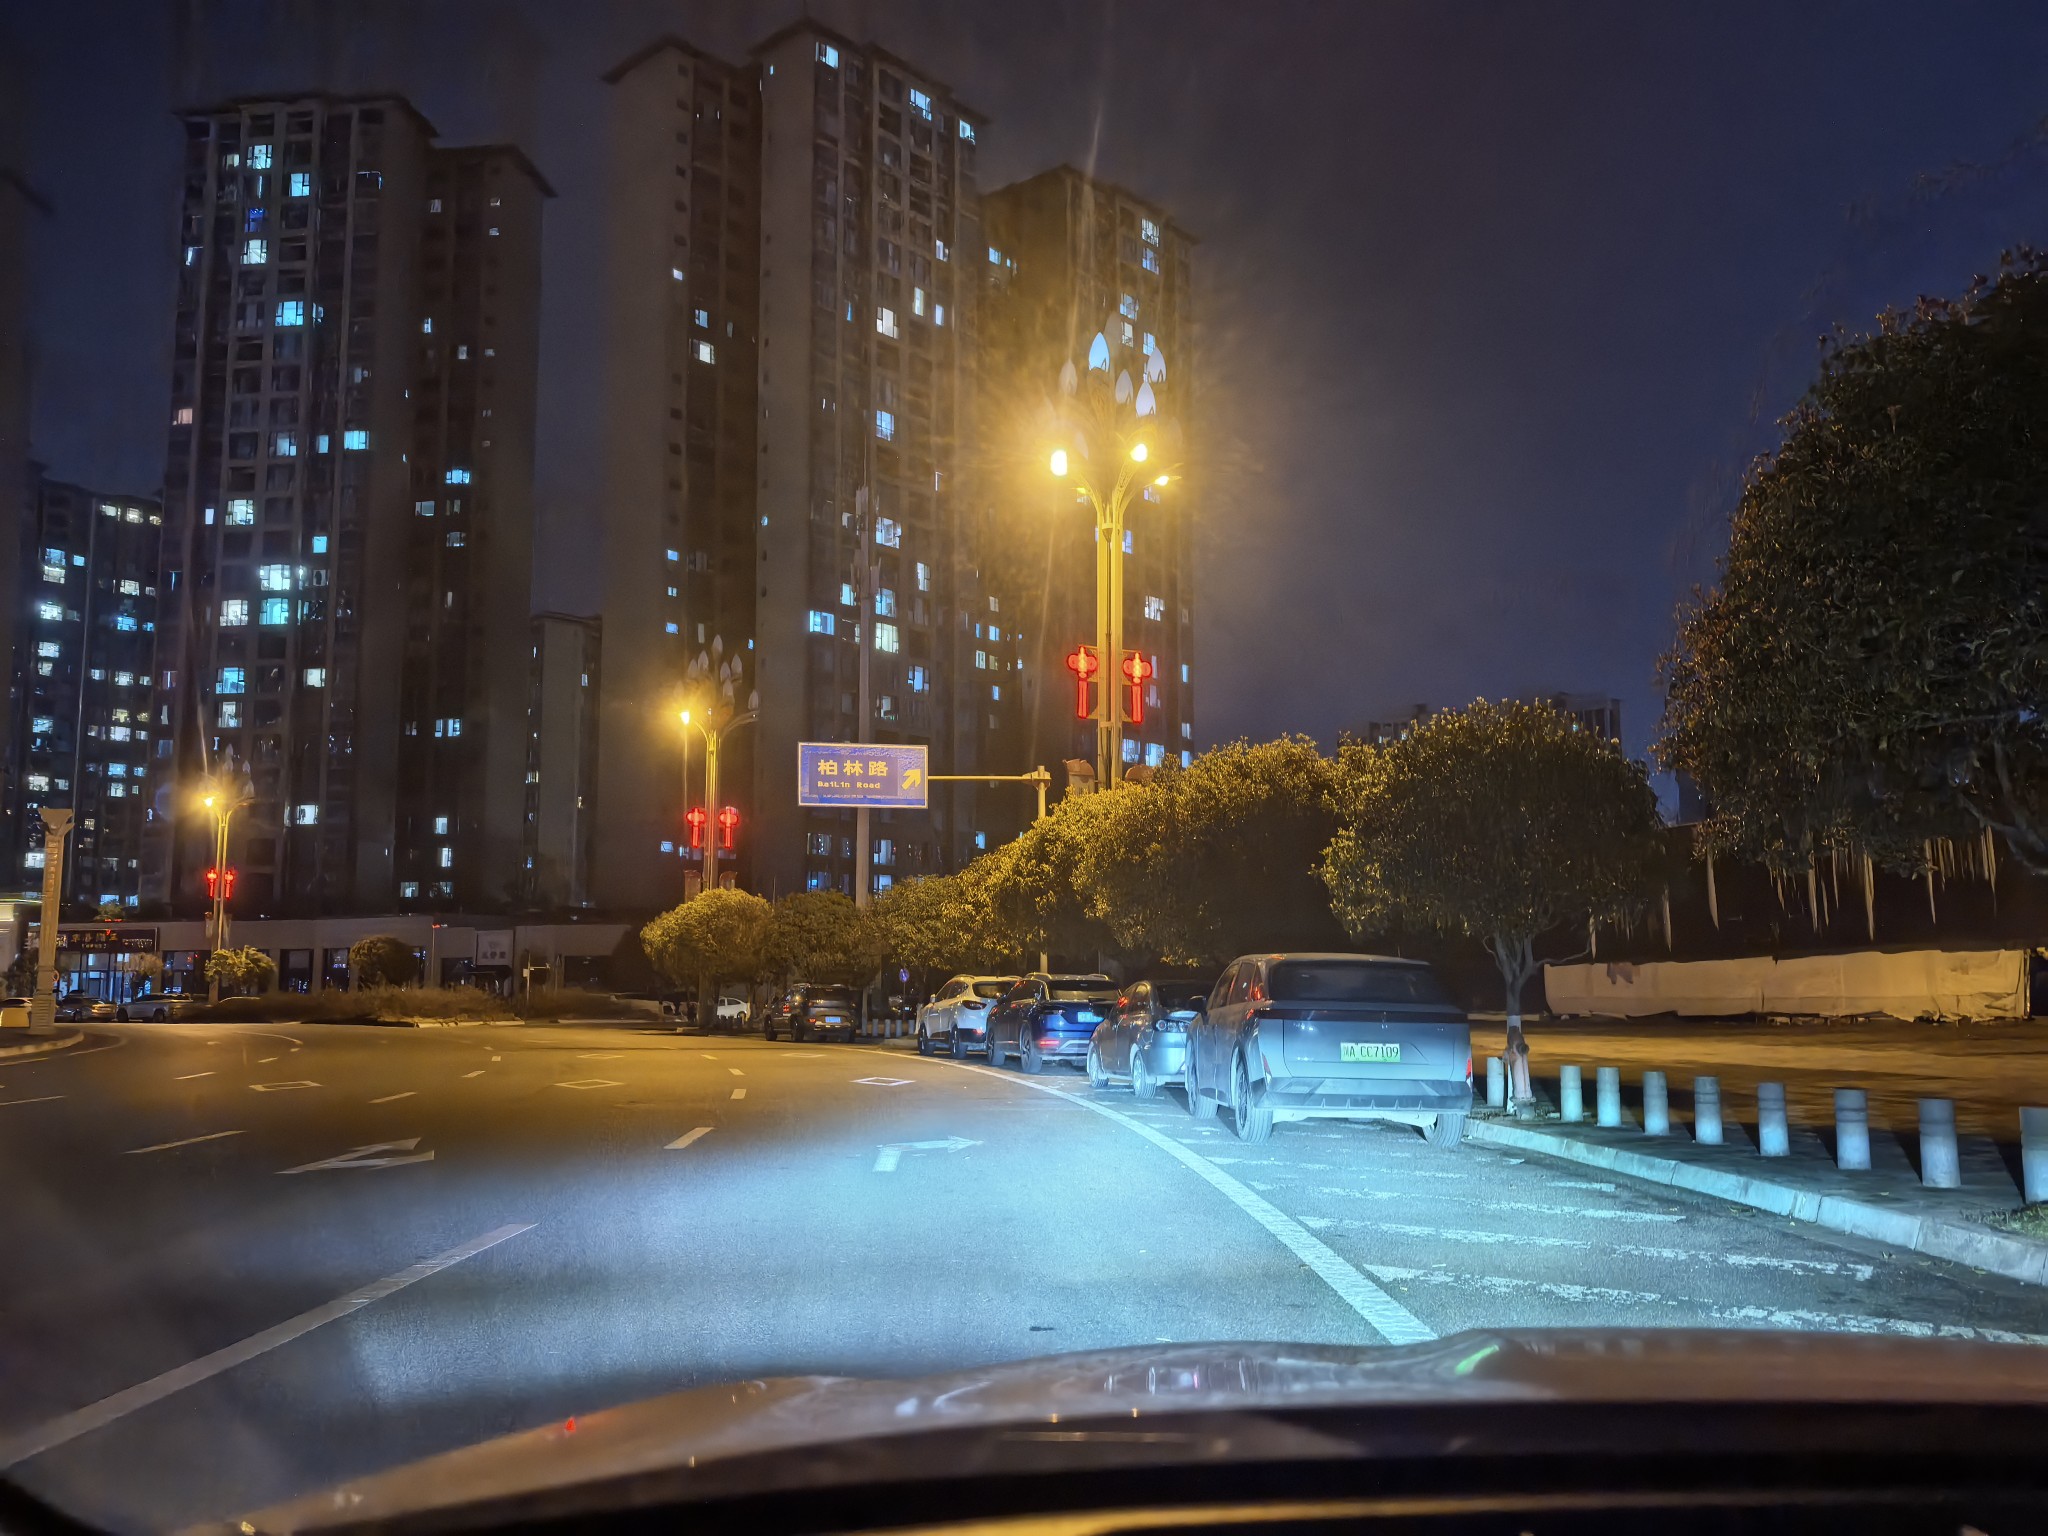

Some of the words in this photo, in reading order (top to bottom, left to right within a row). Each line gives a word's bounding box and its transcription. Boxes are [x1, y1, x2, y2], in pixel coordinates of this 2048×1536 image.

[817, 758, 888, 777] 柏林路
[856, 781, 881, 789] Road
